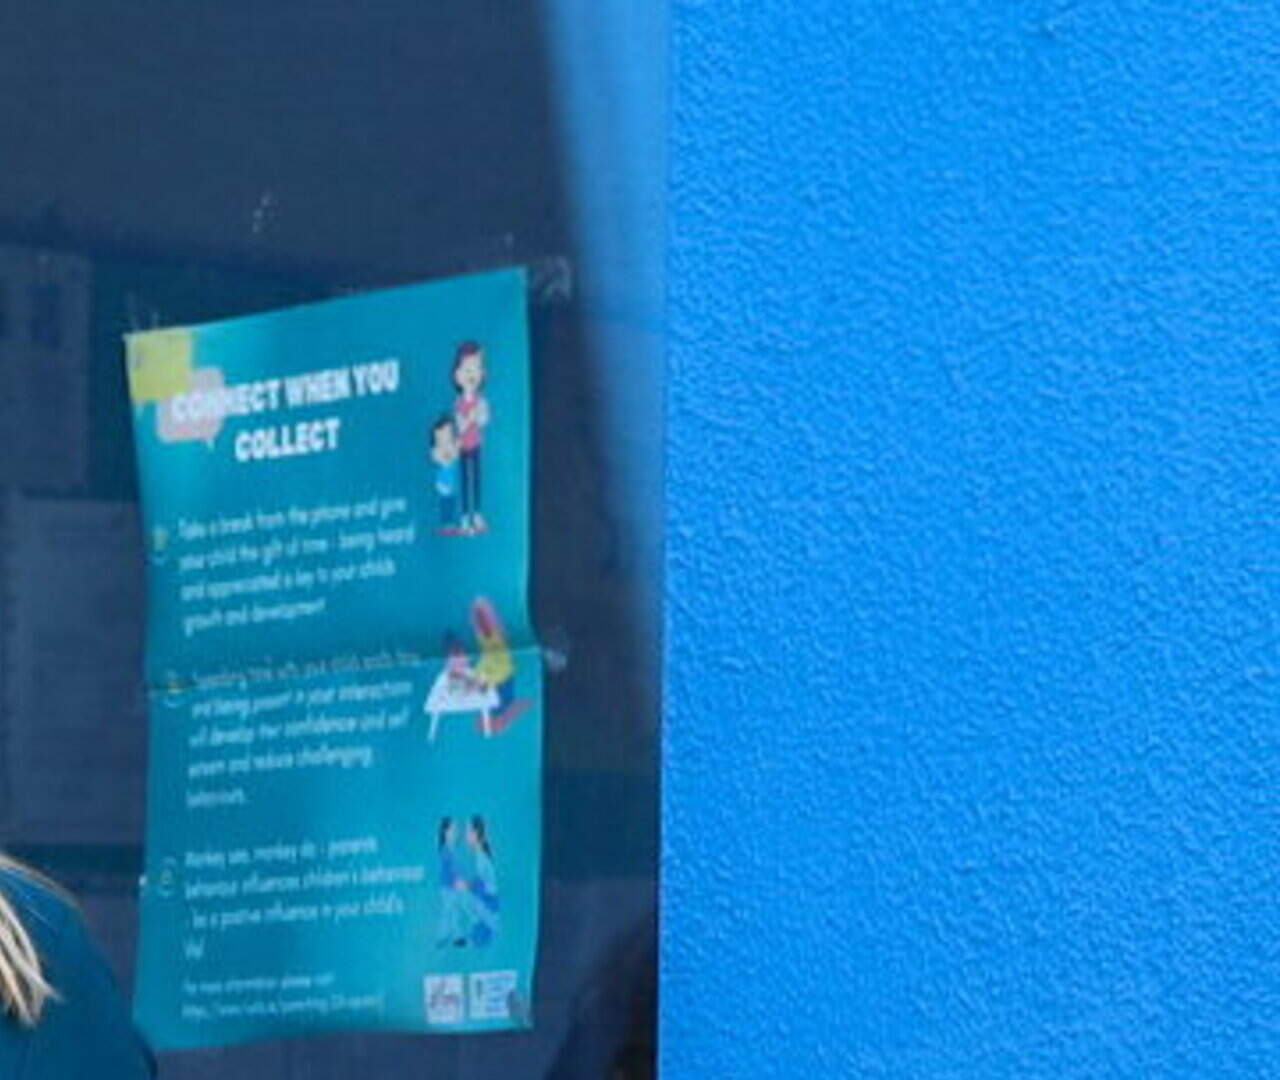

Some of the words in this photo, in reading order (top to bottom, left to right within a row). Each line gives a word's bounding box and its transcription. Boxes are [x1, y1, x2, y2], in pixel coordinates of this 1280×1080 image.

[171, 378, 281, 422] CONNECT
[284, 366, 350, 408] WHEN
[352, 357, 400, 396] YOU
[234, 418, 340, 463] COLLECT
